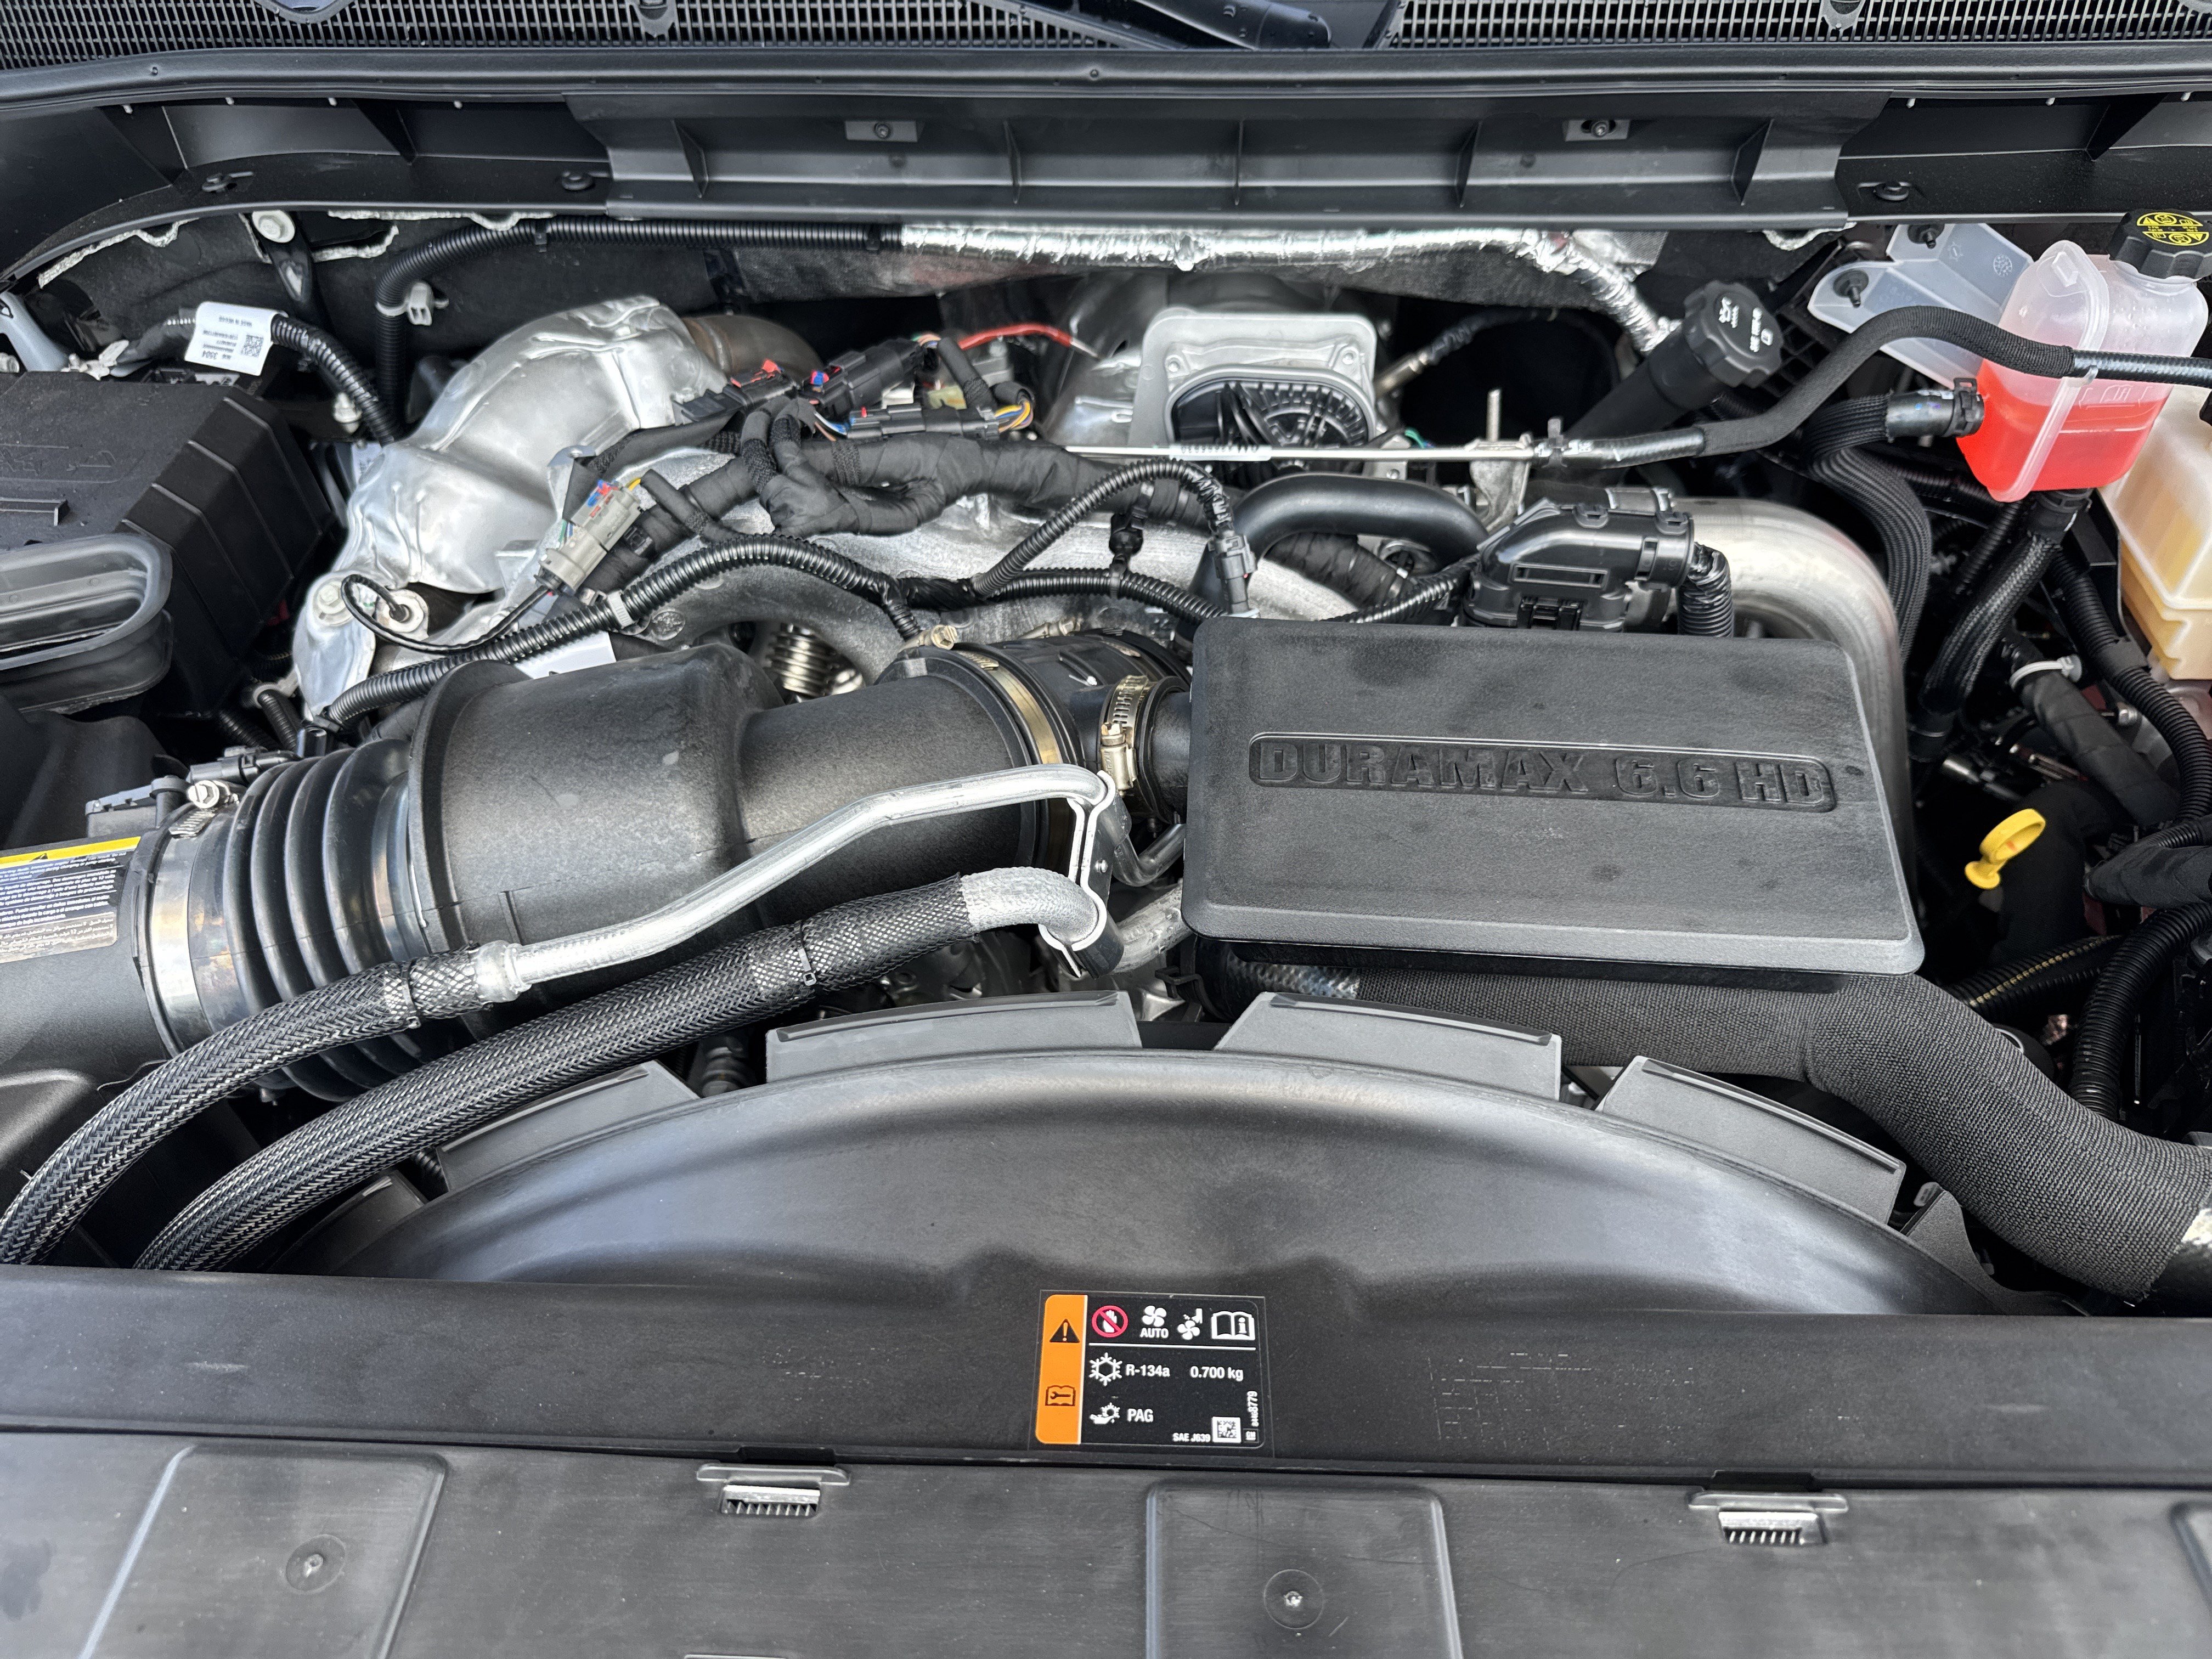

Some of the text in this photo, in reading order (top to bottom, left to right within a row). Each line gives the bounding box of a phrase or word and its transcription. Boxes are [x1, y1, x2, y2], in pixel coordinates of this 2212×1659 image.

[1260, 742, 1825, 805] DURAMAX 6.6 HD
[1140, 1328, 1169, 1339] AUTO
[1126, 1364, 1244, 1381] R-134a 0.700 kg
[1127, 1409, 1154, 1423] PAG
[1172, 1432, 1211, 1443] SAE J639
